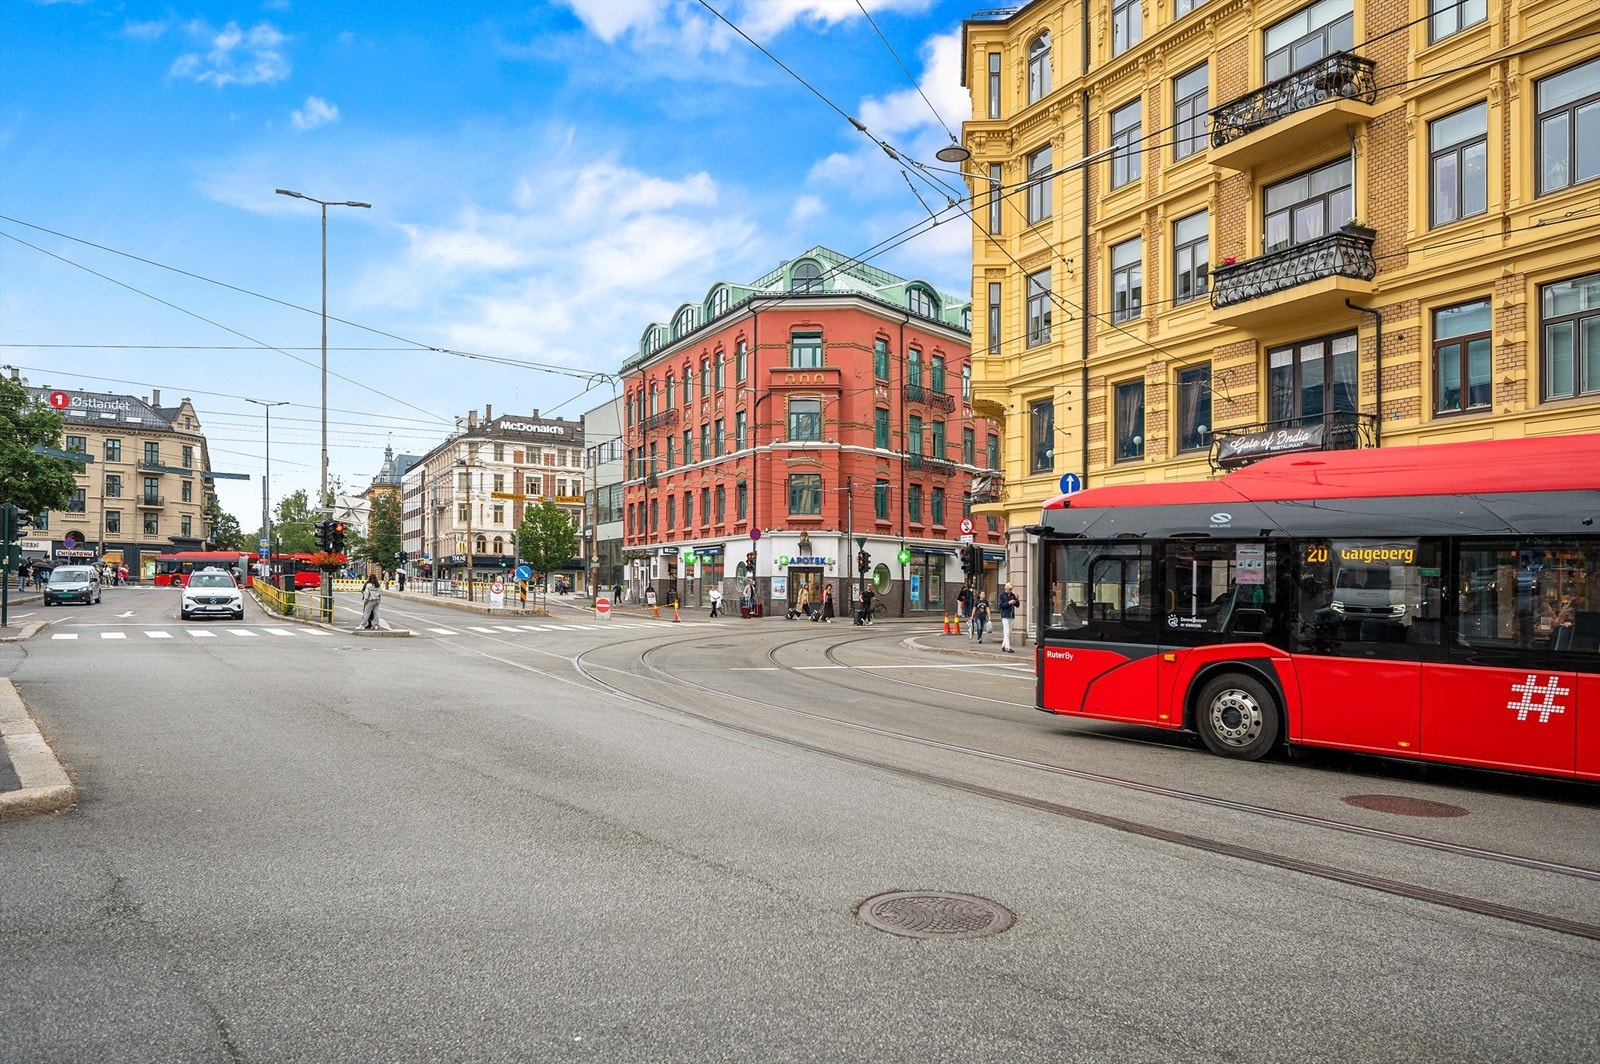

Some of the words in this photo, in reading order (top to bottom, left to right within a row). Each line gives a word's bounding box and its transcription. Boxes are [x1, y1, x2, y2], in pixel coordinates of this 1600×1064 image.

[71, 396, 131, 411] Østlandet
[500, 421, 564, 435] McDonald's
[1230, 437, 1260, 454] Gate
[1261, 432, 1275, 450] of
[1277, 429, 1312, 445] India
[1270, 442, 1305, 451] RESTAURANT
[790, 556, 826, 565] APOTEK
[1307, 545, 1329, 562] 20
[1341, 545, 1414, 564] Galgeberg
